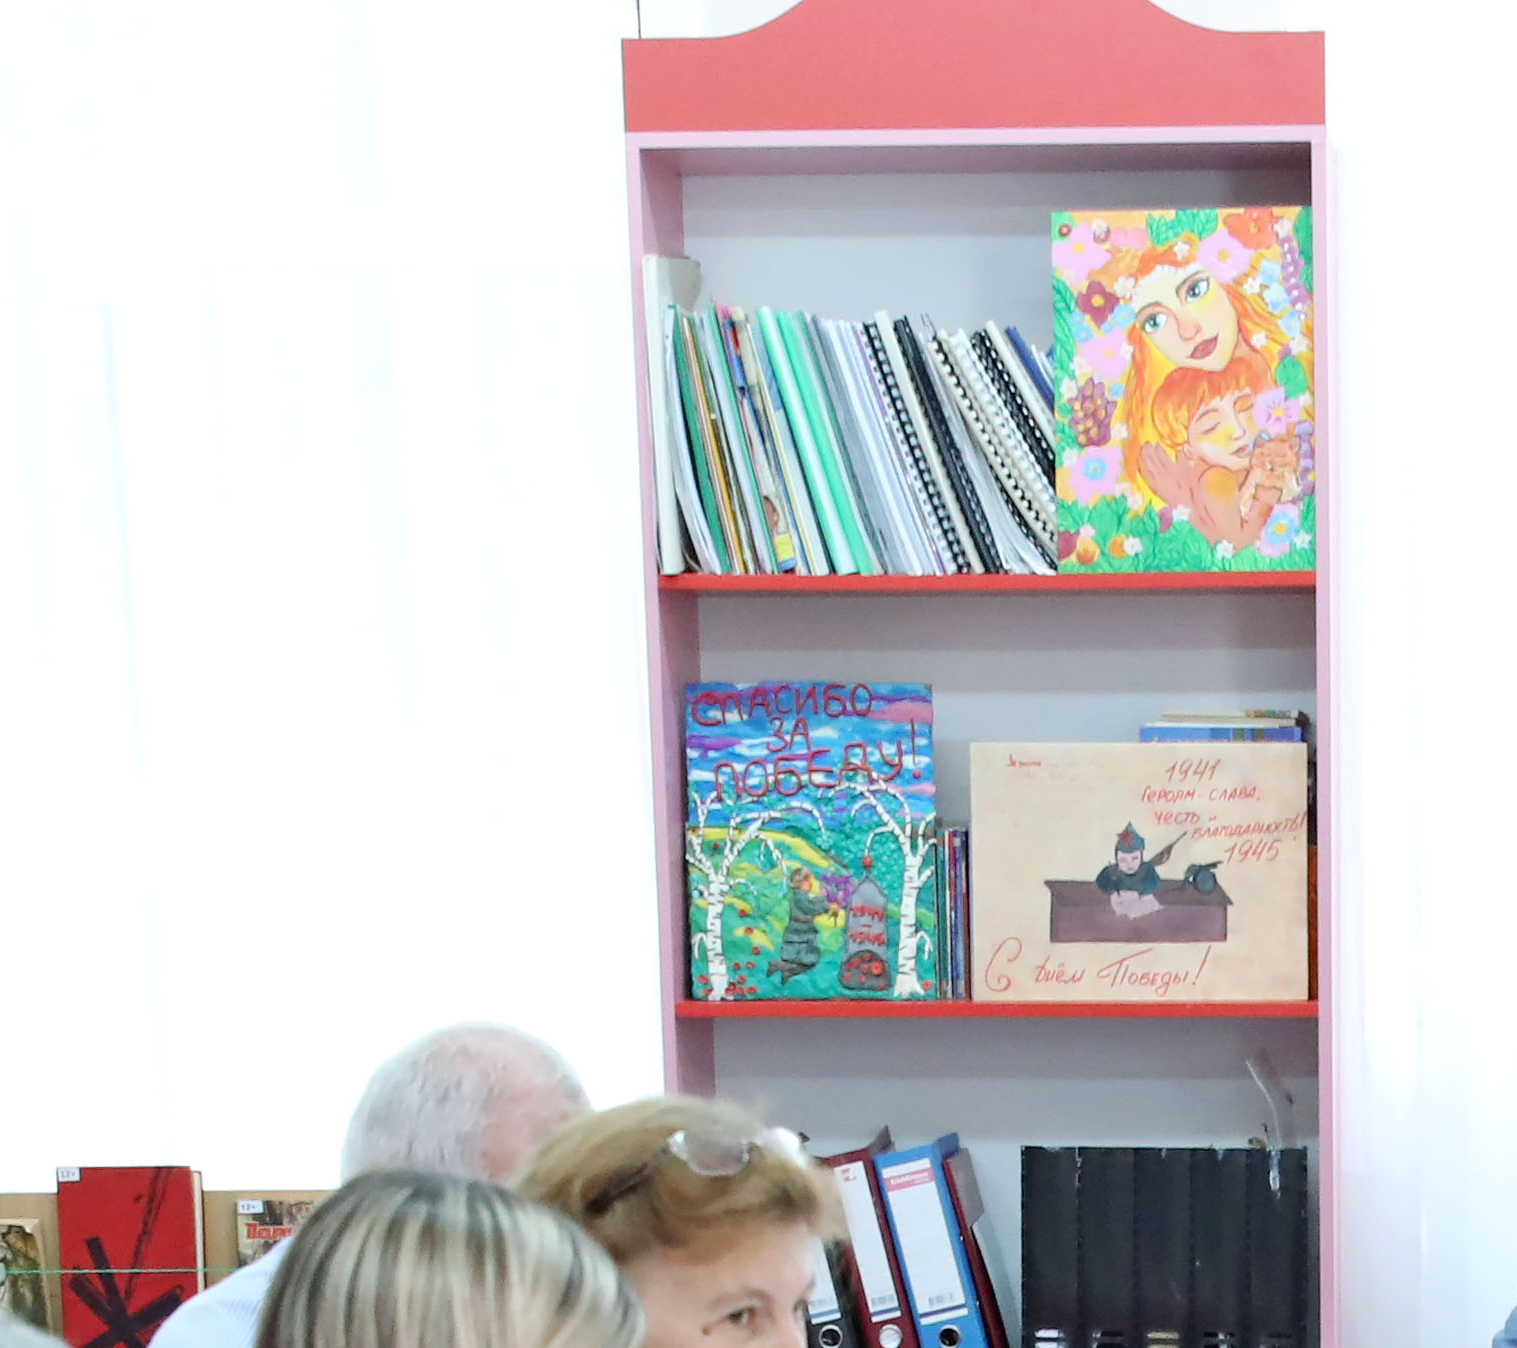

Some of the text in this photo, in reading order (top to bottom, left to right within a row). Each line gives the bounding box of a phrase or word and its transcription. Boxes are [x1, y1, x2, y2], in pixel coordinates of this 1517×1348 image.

[690, 682, 873, 727] СПАСИБО
[765, 715, 812, 753] ЗА
[1165, 758, 1221, 783] 1941
[1223, 838, 1282, 864] 1945
[985, 936, 1023, 992] С
